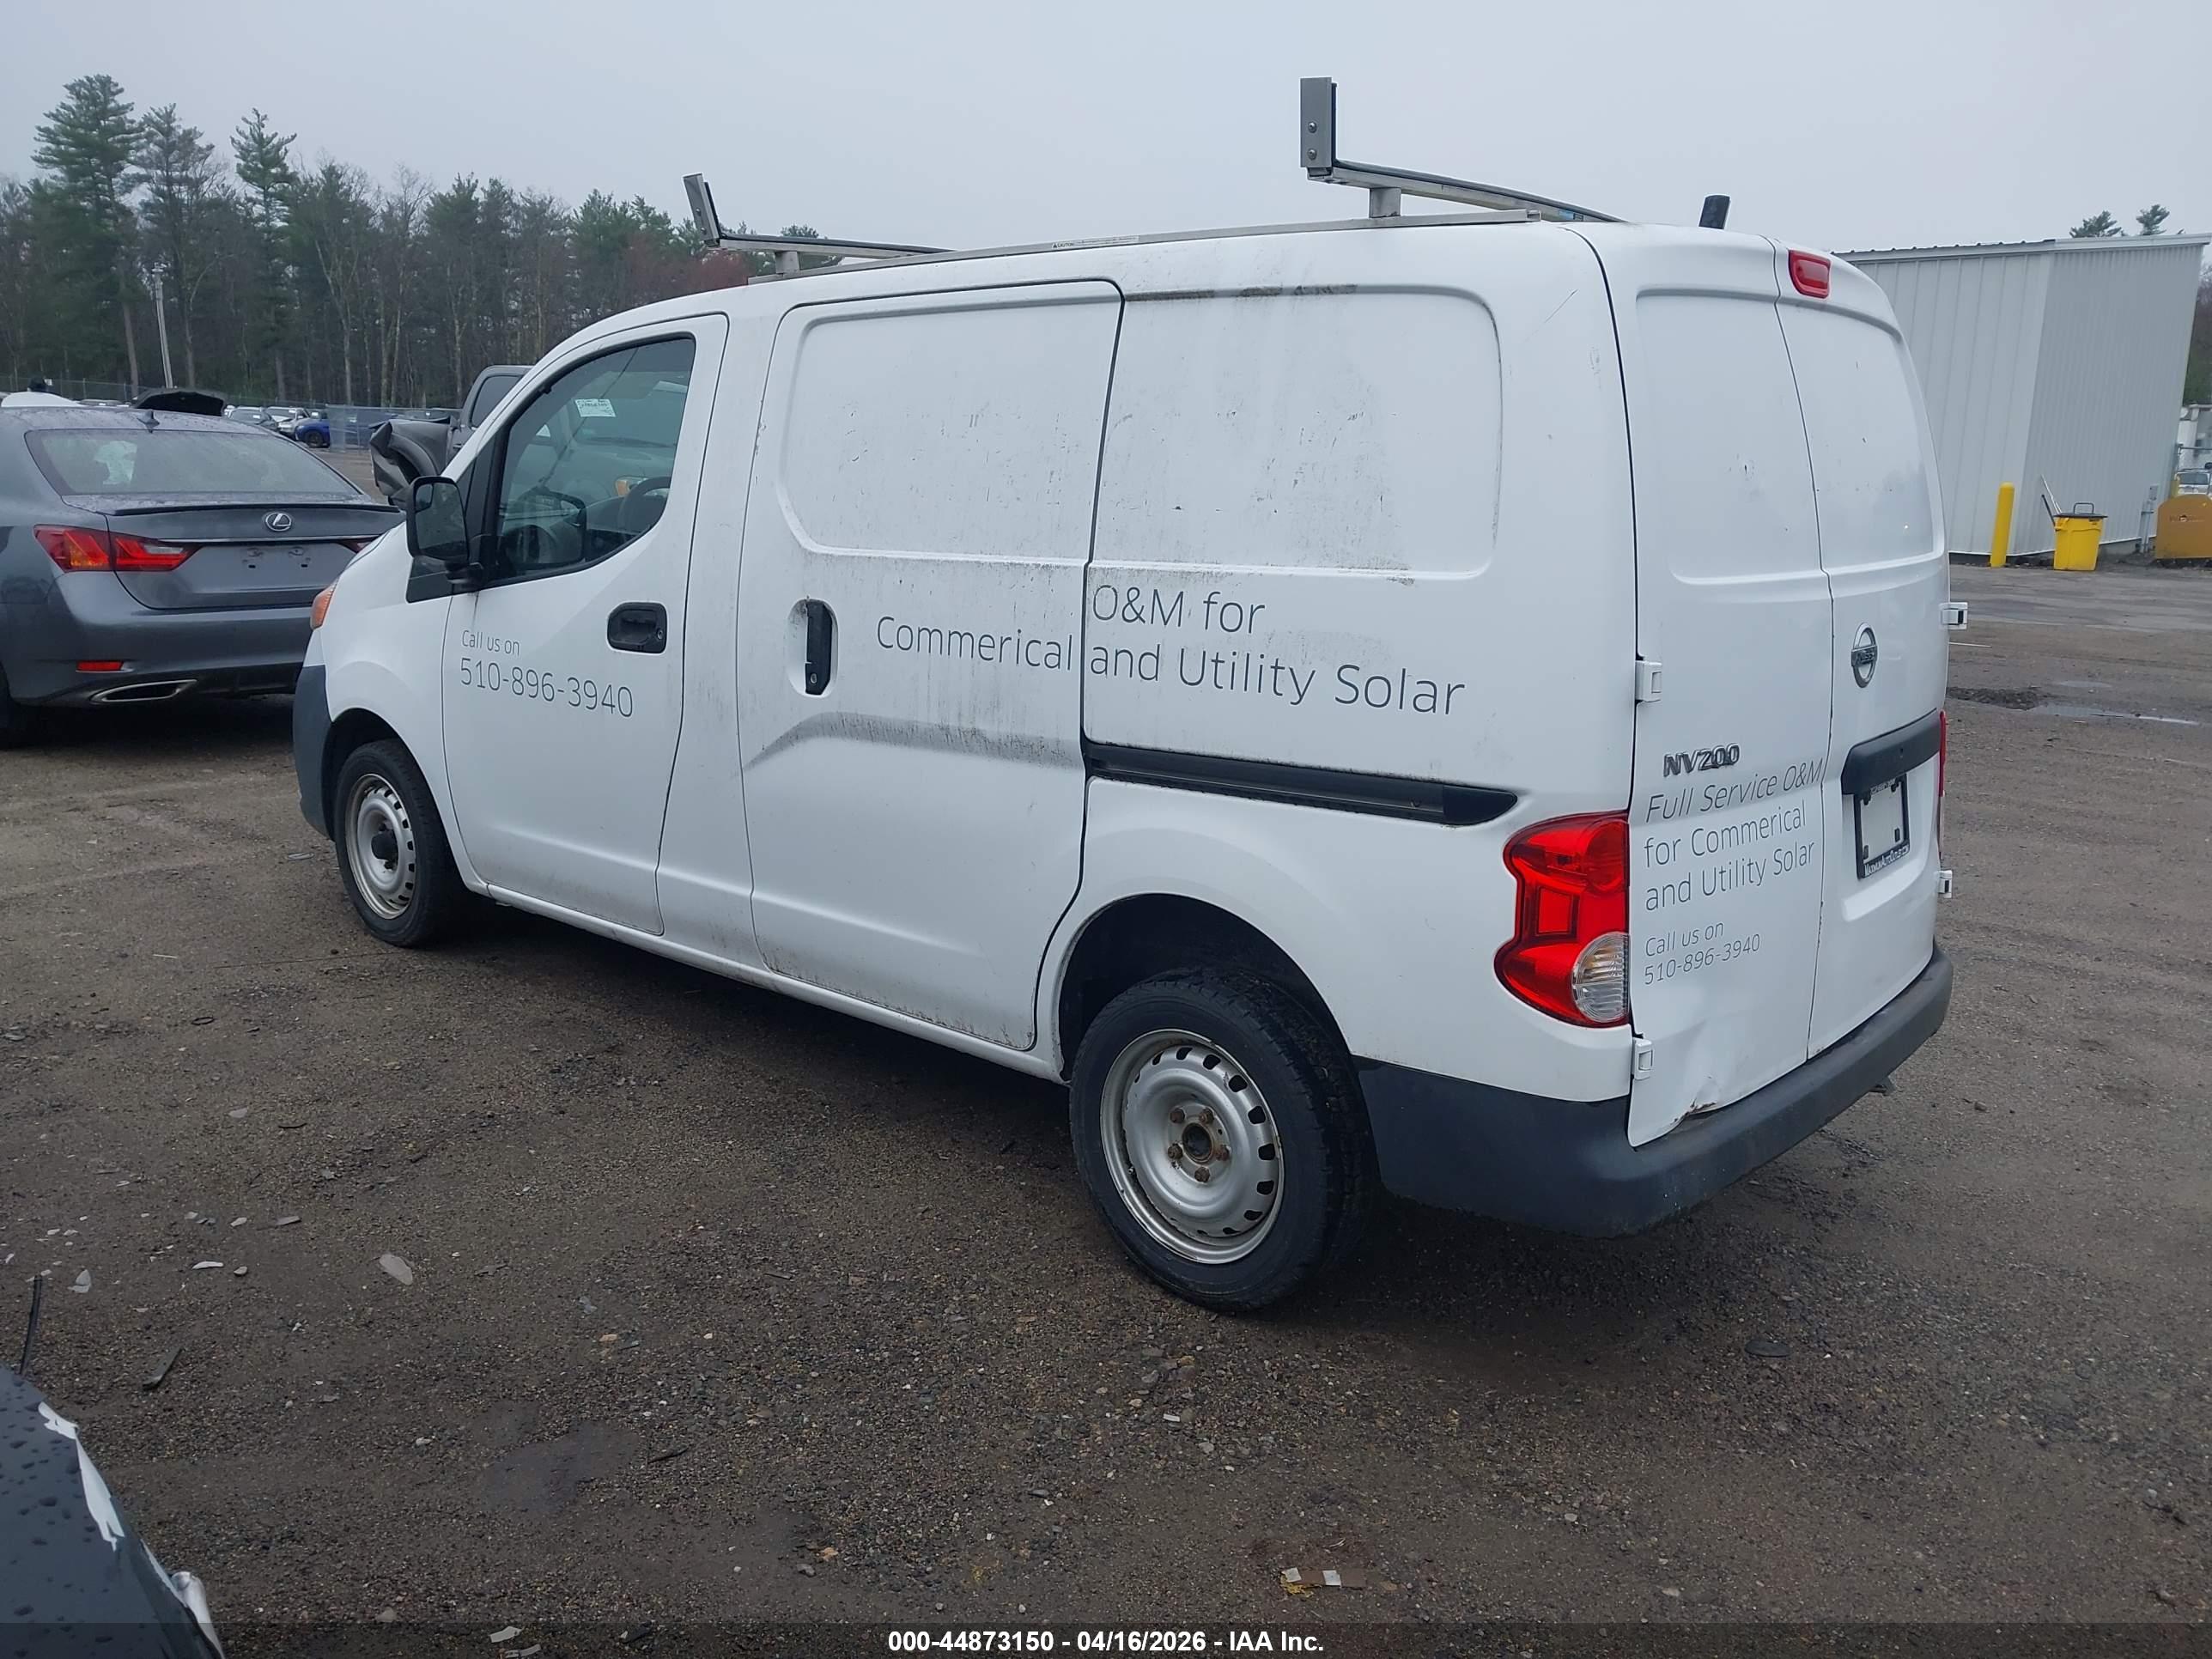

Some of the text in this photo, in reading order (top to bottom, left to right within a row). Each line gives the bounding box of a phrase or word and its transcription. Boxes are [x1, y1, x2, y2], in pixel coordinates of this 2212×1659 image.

[1093, 585, 1266, 634] O&M for
[462, 630, 520, 656] Call us on
[878, 616, 1465, 714] Commerical and Utility Solar
[461, 658, 633, 717] 510-896-3940
[1663, 744, 1740, 777] NV200
[1646, 758, 1823, 823] Full Service O&M
[1644, 799, 1806, 867] for Commerical
[1645, 842, 1814, 910] and Utility Solar
[1644, 933, 1760, 985] 510-896-3940
[1645, 922, 1723, 957] Call us on
